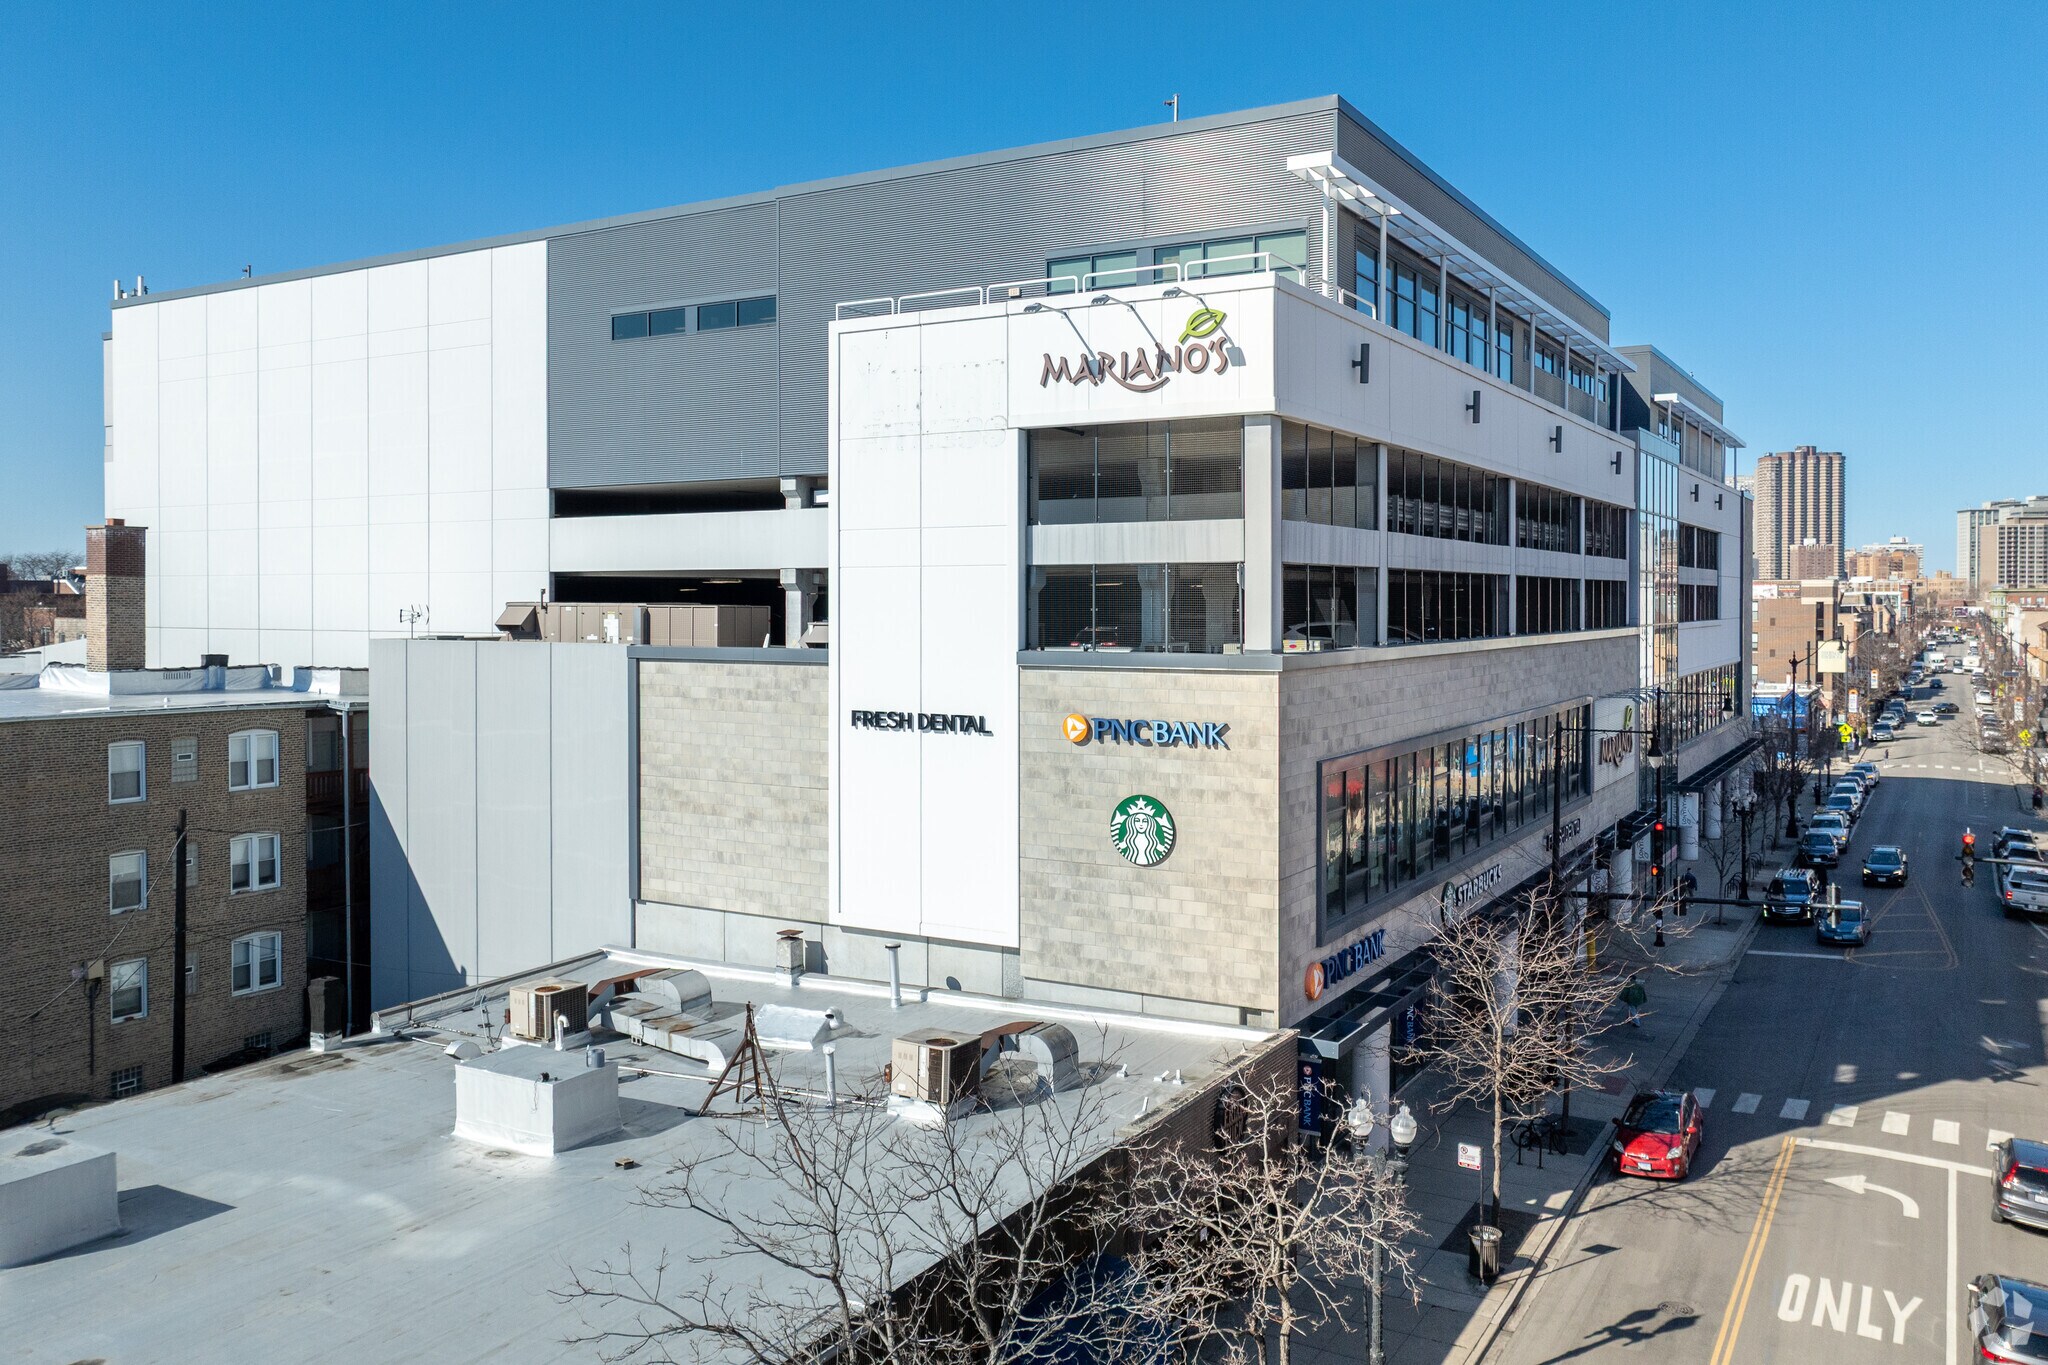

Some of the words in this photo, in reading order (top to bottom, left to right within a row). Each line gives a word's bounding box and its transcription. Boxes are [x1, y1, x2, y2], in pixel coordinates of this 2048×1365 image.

[1040, 336, 1228, 392] MARIANO'S
[851, 709, 914, 731] FRESH
[917, 712, 993, 735] DENTAL
[1456, 864, 1502, 907] STARBUCKS
[1303, 1076, 1312, 1099] PC
[1777, 1273, 1923, 1345] ONLY
